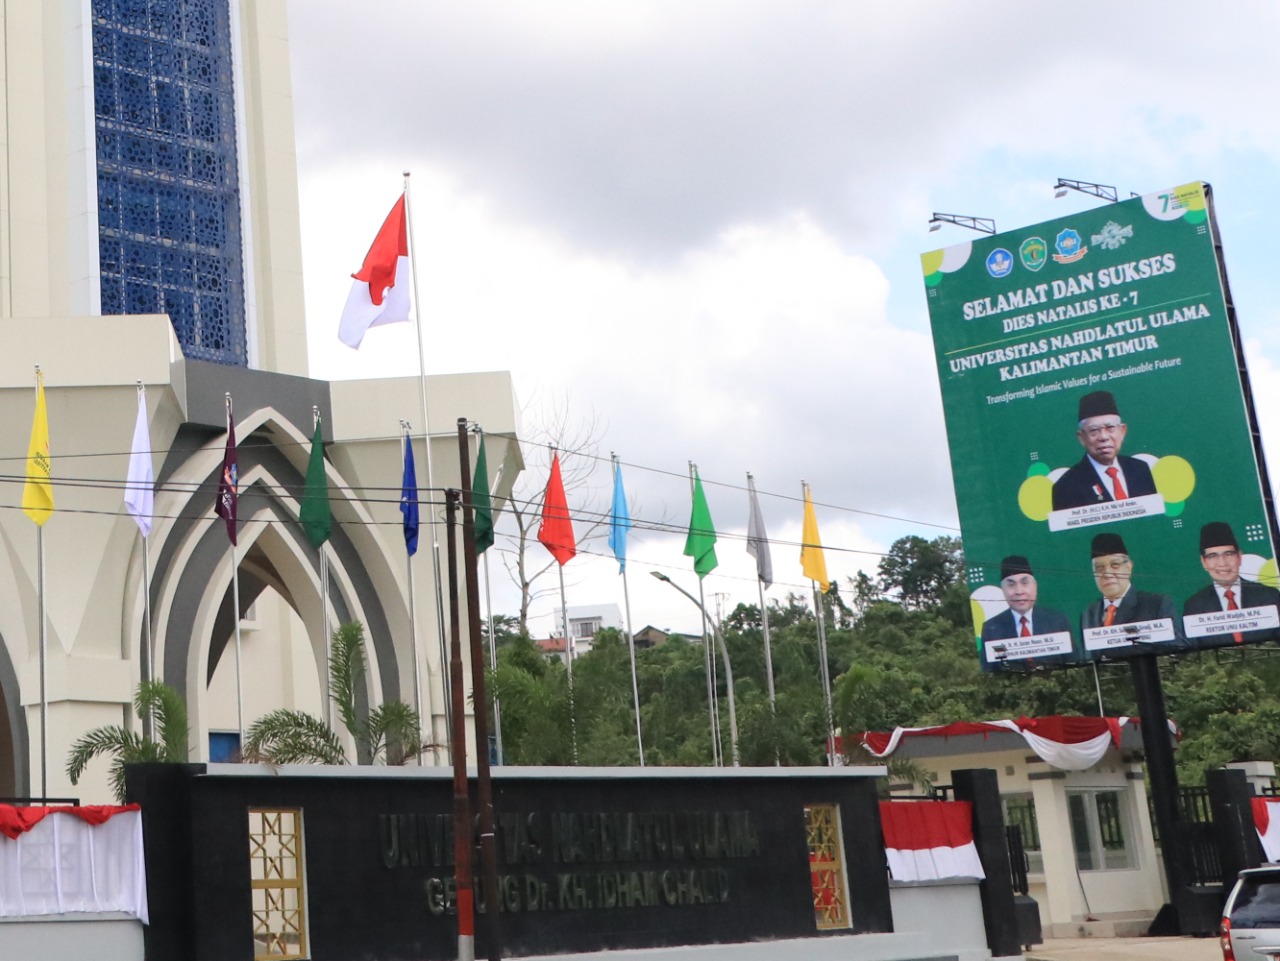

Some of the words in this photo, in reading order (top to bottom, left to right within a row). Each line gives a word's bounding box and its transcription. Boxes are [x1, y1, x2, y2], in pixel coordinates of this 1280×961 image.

[1158, 193, 1169, 213] 7
[963, 283, 1048, 321] SELAMAT
[1052, 271, 1095, 300] DAN
[1098, 253, 1176, 290] SUKSES
[1003, 312, 1035, 334] DIES
[1037, 298, 1098, 325] NATALIS
[1099, 294, 1122, 311] KE
[1129, 290, 1139, 306] 7
[949, 339, 1049, 374] UNIVERSITAS
[1051, 316, 1148, 351] NAHDLATUL
[1150, 302, 1211, 328] ULAMA
[999, 347, 1103, 382] KALIMANTAN
[1105, 334, 1159, 359] TIMUR
[986, 386, 1035, 405] Transforming
[1035, 380, 1062, 397] Islamic
[1062, 375, 1088, 390] Values
[1088, 373, 1101, 387] for
[1108, 361, 1154, 380] Sustainable
[1154, 355, 1182, 371] Future
[1205, 625, 1225, 633] REKTOR
[1238, 621, 1259, 629] KALTIM
[425, 874, 522, 916] GEUNG
[524, 873, 553, 912] Dr.
[557, 871, 593, 910] KH.
